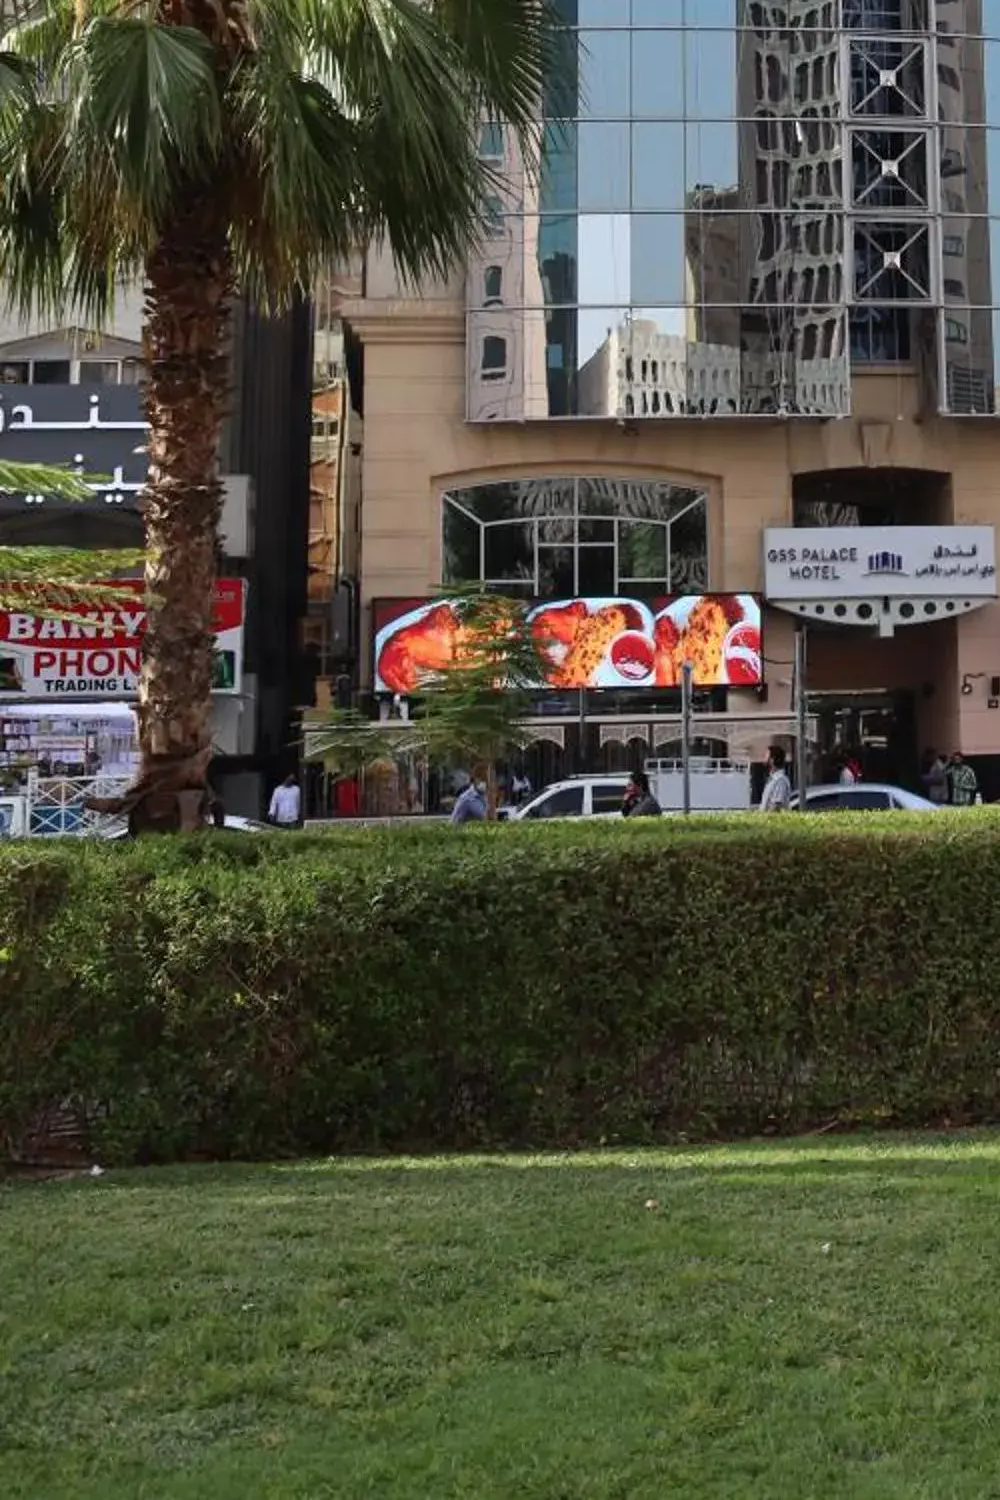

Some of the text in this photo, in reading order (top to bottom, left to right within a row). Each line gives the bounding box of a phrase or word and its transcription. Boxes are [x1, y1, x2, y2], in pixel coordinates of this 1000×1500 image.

[767, 547, 858, 563] GSS PALACE
[789, 565, 841, 581] HOTEL
[33, 650, 142, 677] PHON
[44, 678, 117, 692] TRADING
